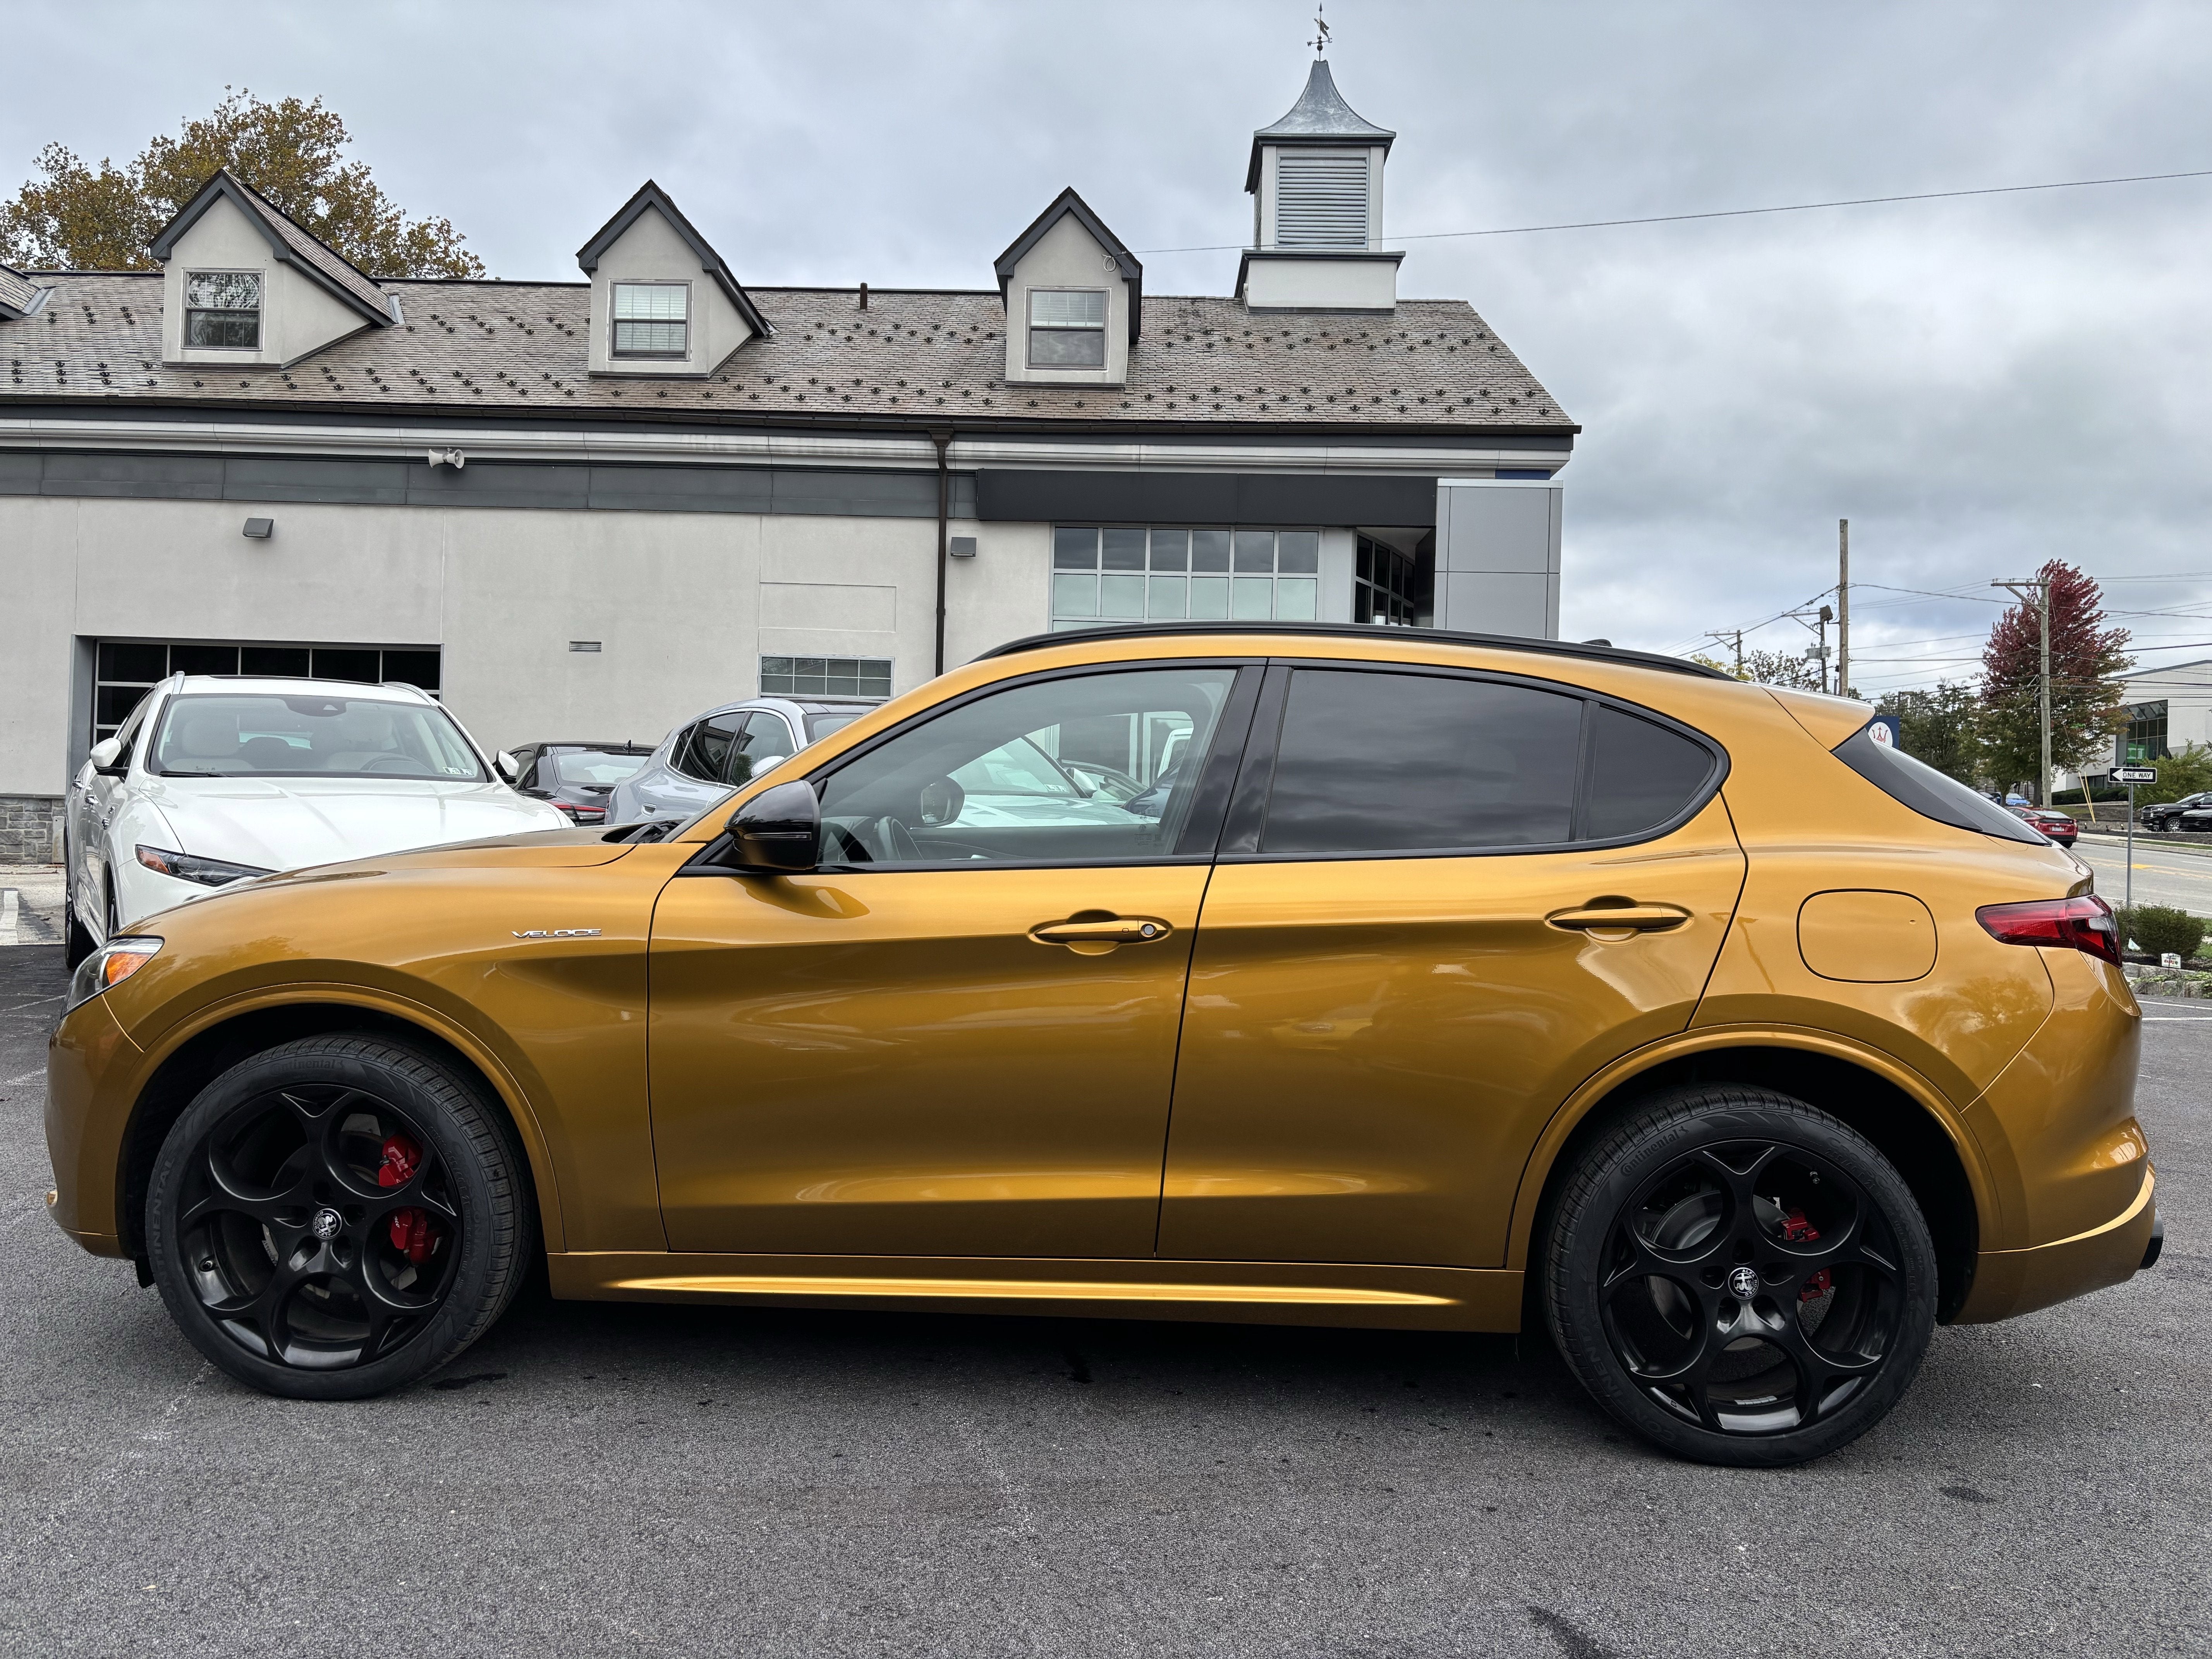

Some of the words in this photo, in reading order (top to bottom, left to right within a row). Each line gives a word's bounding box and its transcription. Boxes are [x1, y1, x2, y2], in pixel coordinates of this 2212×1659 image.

[511, 929, 601, 938] VELOCE
[1620, 1129, 1680, 1177] Continental
[314, 1211, 323, 1229] ROMEO
[152, 1158, 185, 1317] CONTINENTAL
[1742, 1269, 1755, 1278] ALFA
[1745, 1279, 1757, 1296] ROMEO
